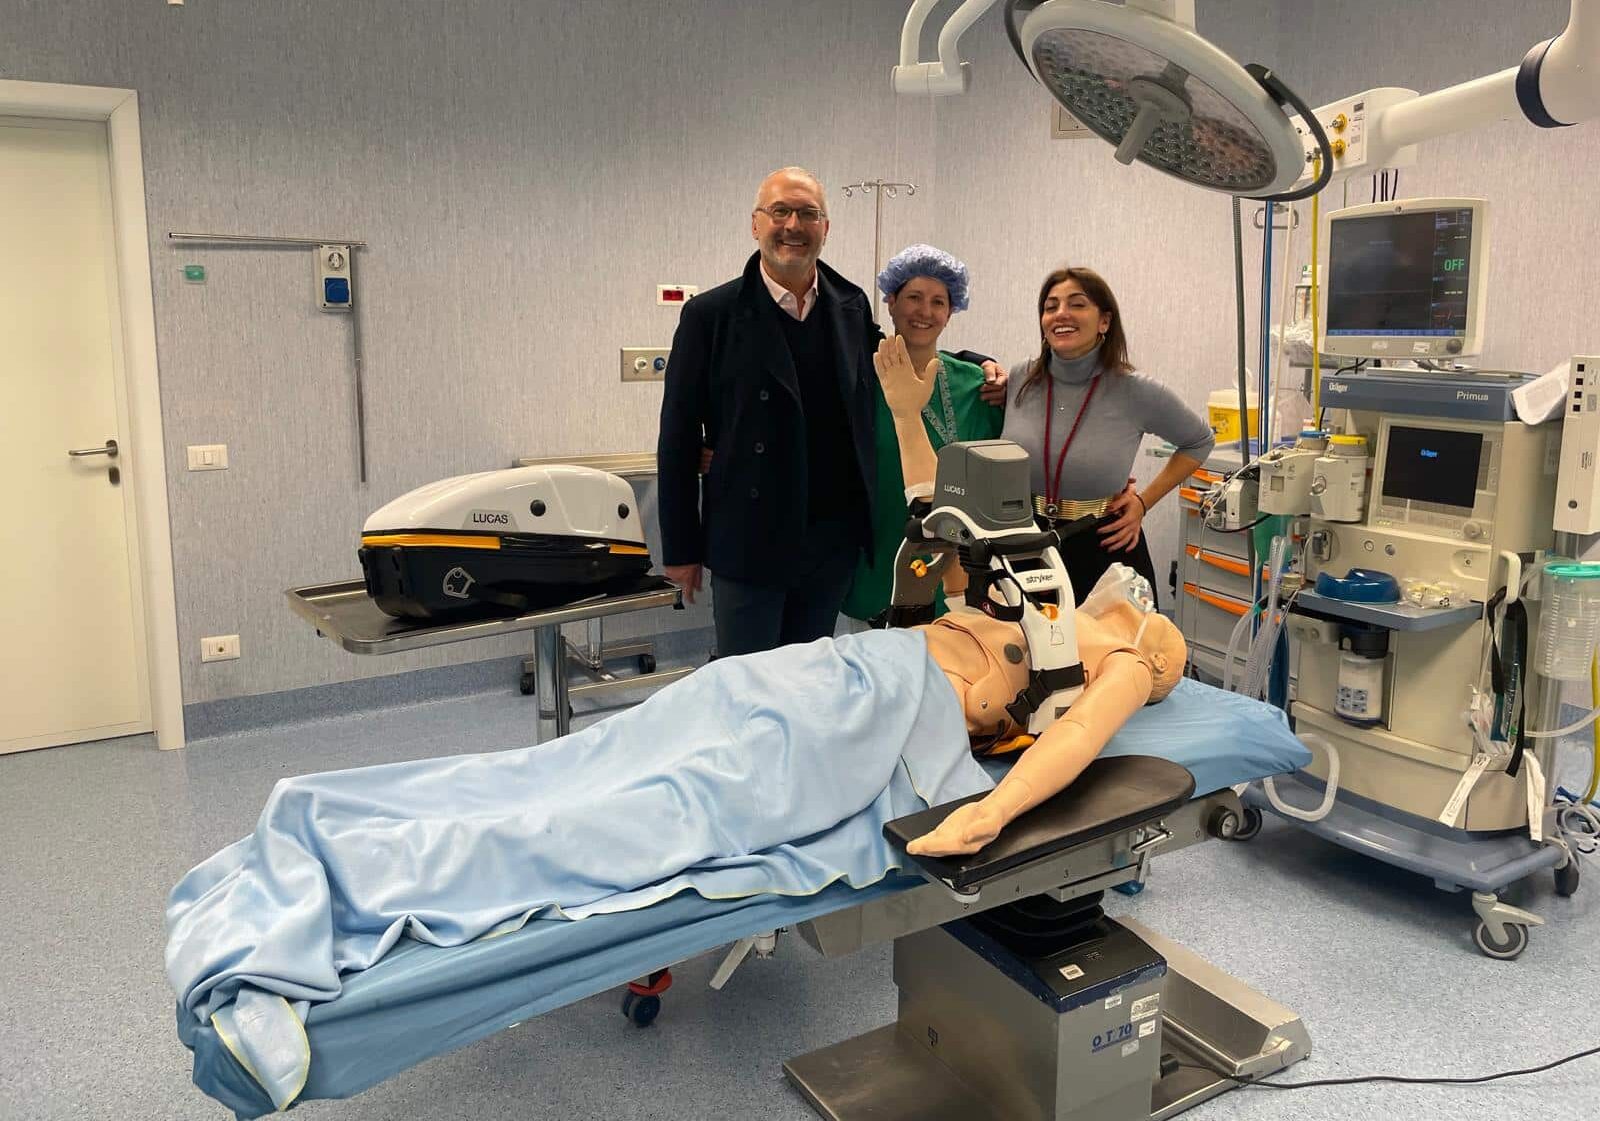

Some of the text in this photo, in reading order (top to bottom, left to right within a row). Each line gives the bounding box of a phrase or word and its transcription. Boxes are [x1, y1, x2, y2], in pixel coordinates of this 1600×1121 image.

[1444, 259, 1465, 271] OFF
[1456, 391, 1489, 401] Primus
[944, 484, 961, 496] LUCAS
[473, 512, 509, 525] LUCAS
[1025, 574, 1054, 585] stryker
[1118, 1023, 1133, 1038] 70
